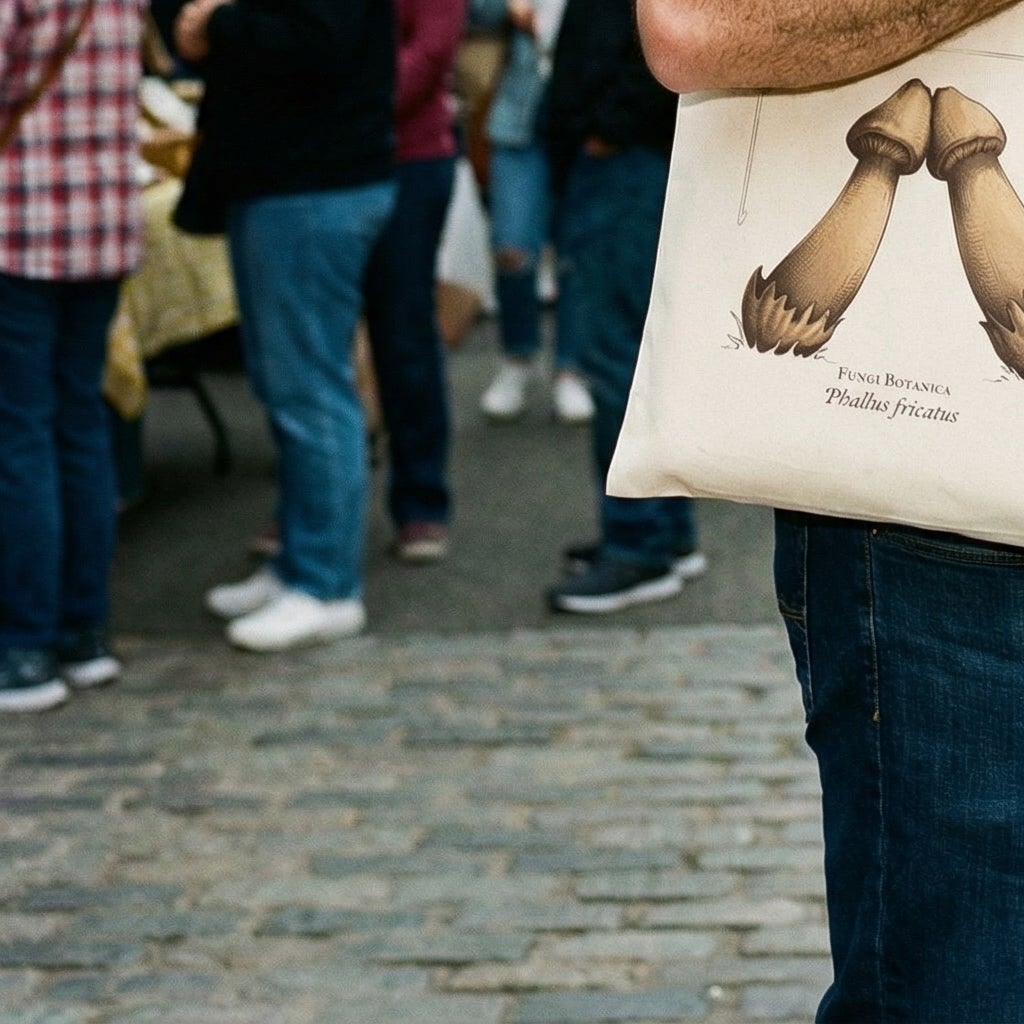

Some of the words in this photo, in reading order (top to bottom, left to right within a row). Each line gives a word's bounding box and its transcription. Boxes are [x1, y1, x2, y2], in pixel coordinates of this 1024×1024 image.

[838, 366, 880, 385] FUNGI
[884, 373, 951, 396] BOTANICA
[825, 387, 890, 413] Phallus
[887, 397, 960, 423] fricatus
